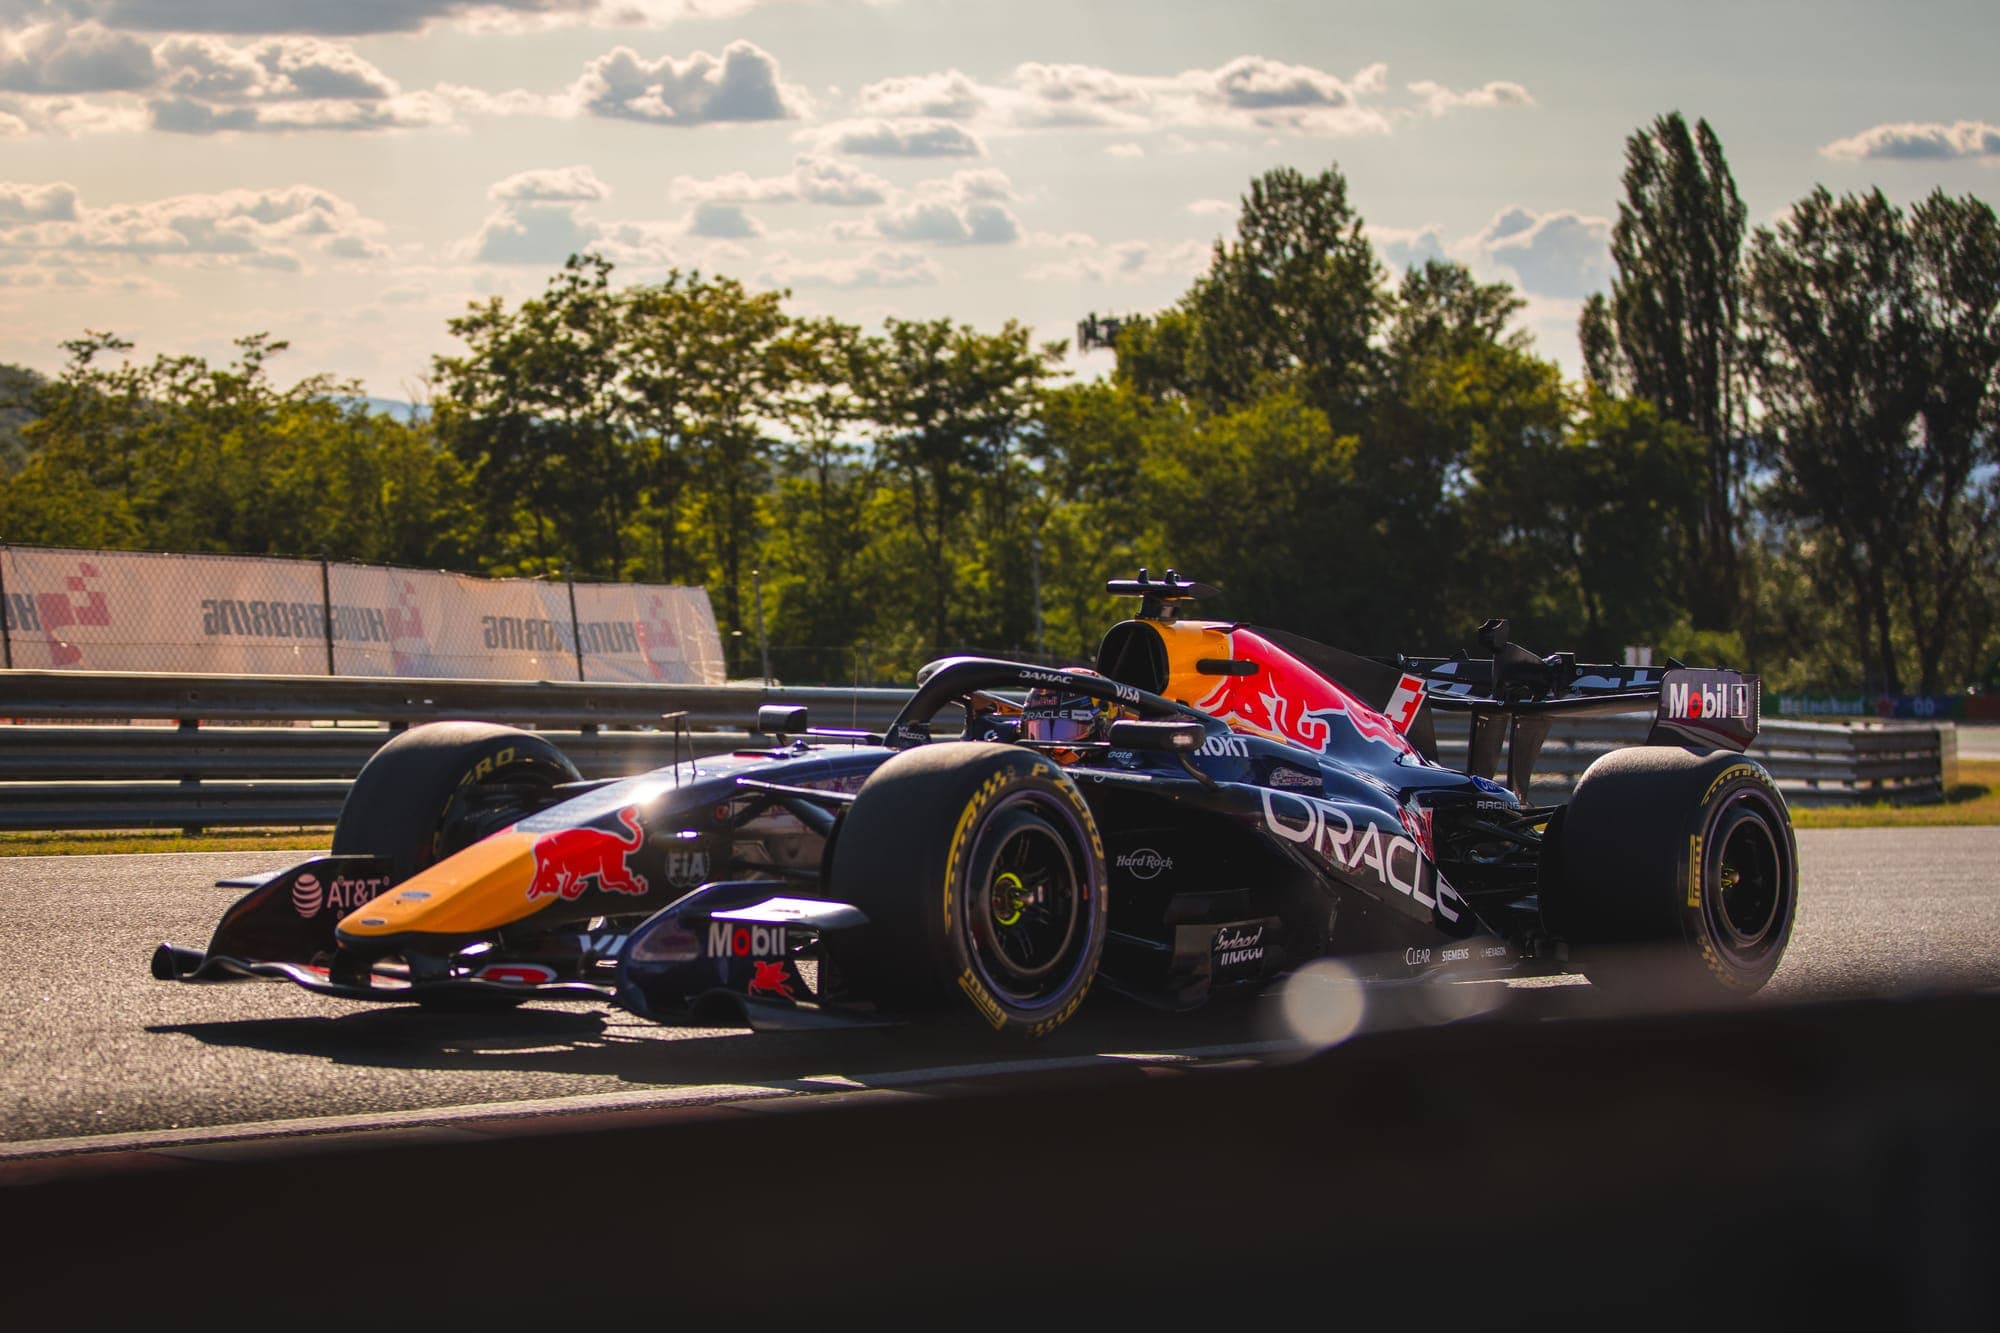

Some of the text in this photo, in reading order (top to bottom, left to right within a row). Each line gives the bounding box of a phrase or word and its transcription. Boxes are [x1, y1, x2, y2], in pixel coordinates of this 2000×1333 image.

[1018, 670, 1074, 685] DAMAC
[1115, 684, 1140, 704] VISA
[1668, 683, 1727, 719] Mobil
[1476, 801, 1521, 810] RACING
[1116, 855, 1174, 870] Hard Rock
[1261, 787, 1460, 924] ORACLE
[326, 879, 381, 909] AT&T
[707, 921, 786, 958] Mobil
[1405, 947, 1431, 966] CLEAR
[1441, 948, 1470, 962] SIEMENS
